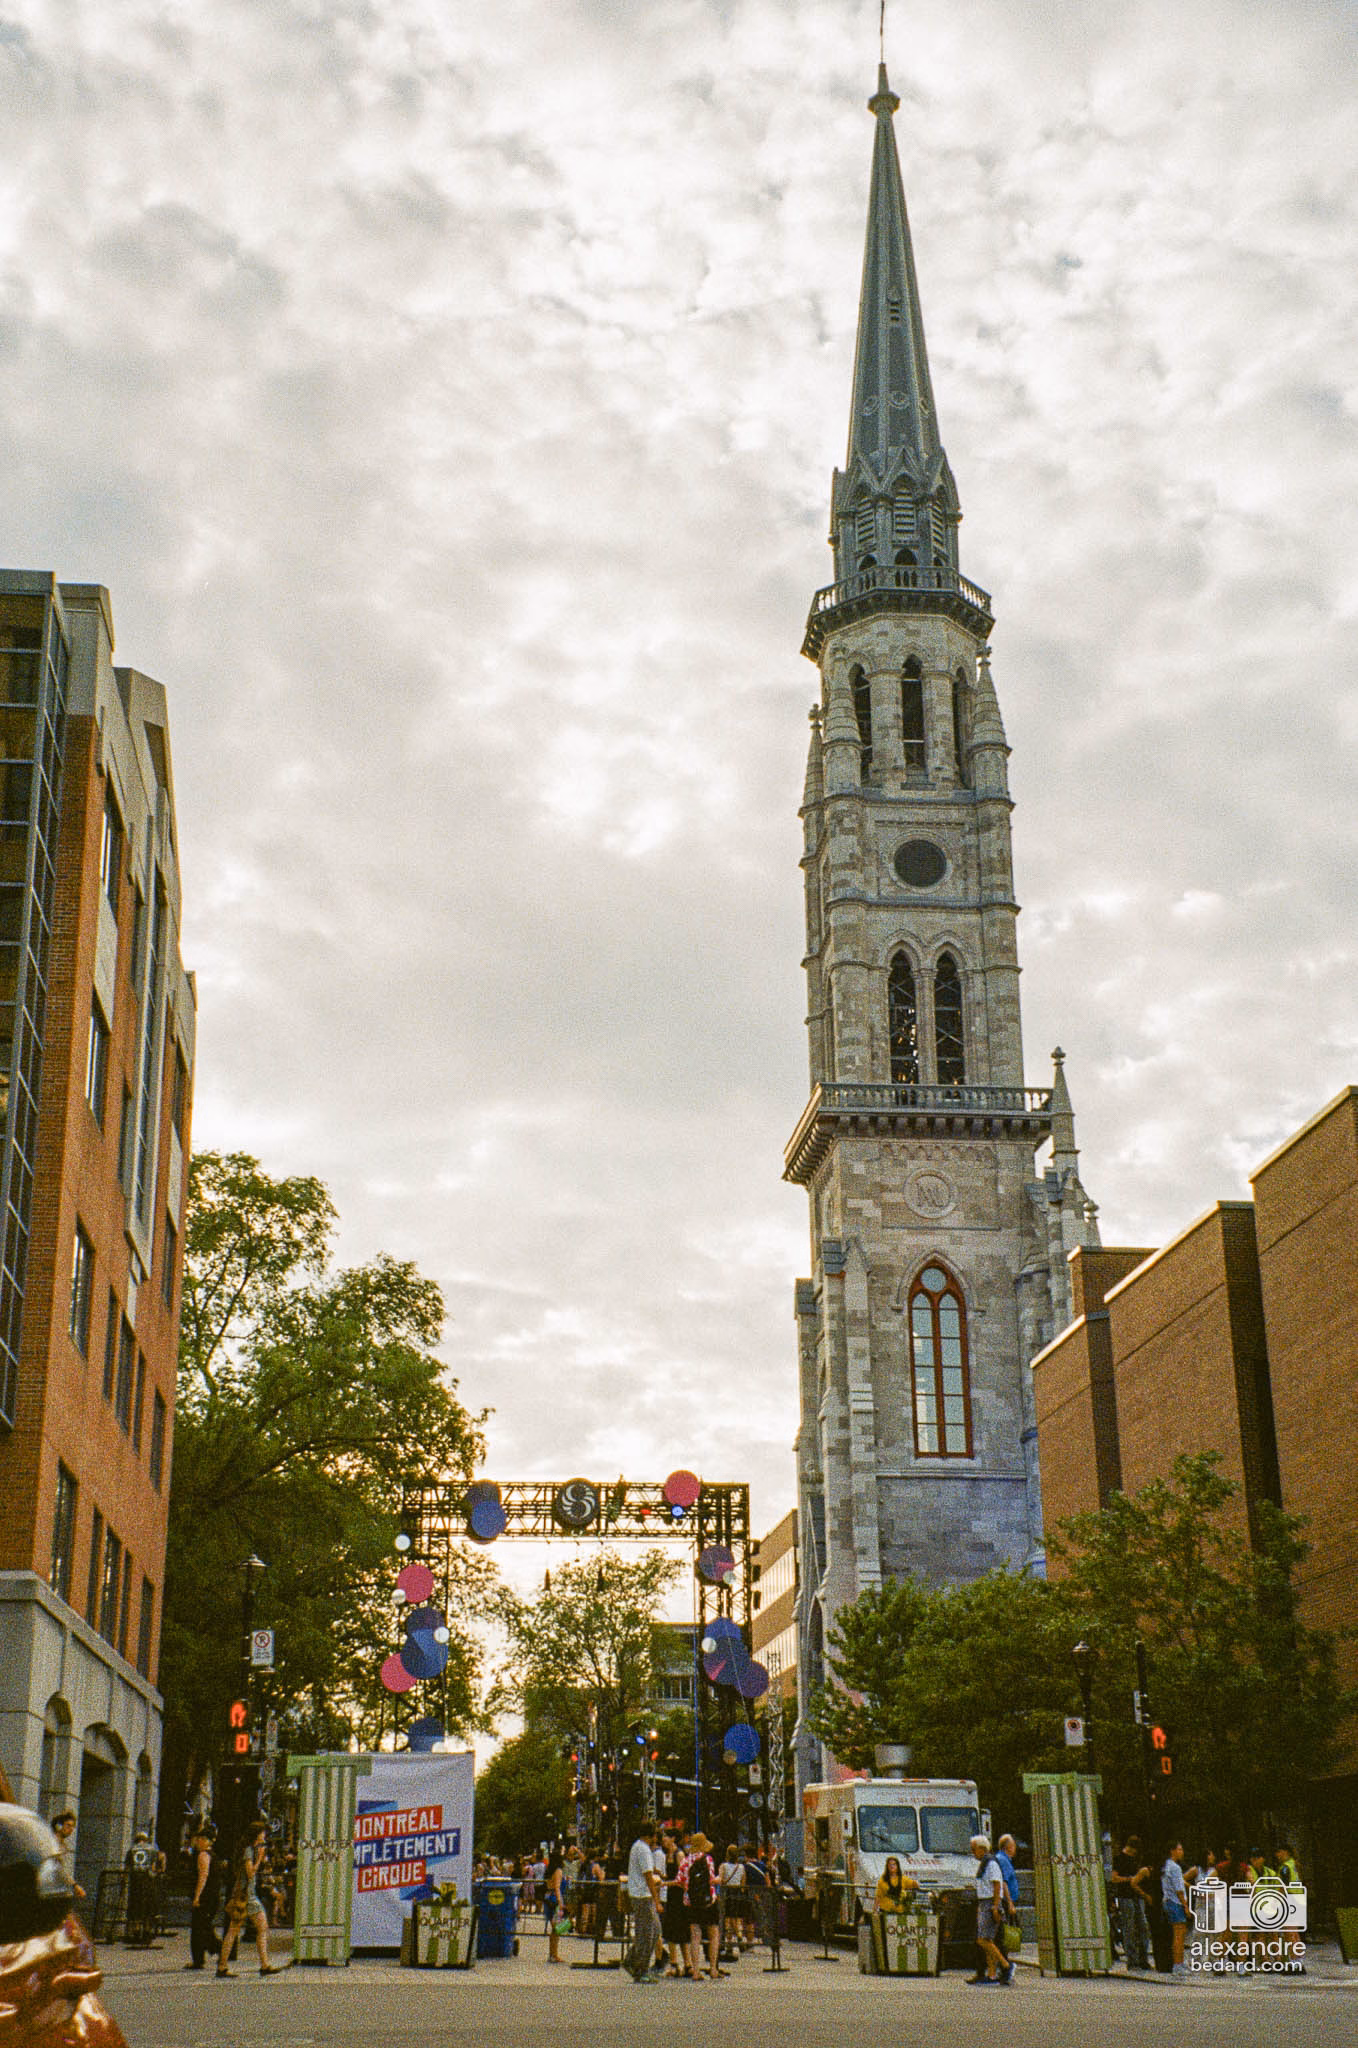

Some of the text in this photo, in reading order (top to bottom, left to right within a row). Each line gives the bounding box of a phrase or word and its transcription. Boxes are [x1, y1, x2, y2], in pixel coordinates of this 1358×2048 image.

[300, 1838, 353, 1850] QUARTIER
[1051, 1854, 1101, 1865] QUARTIER
[420, 1916, 470, 1927] QUARTIER
[887, 1925, 936, 1936] QUARTIER
